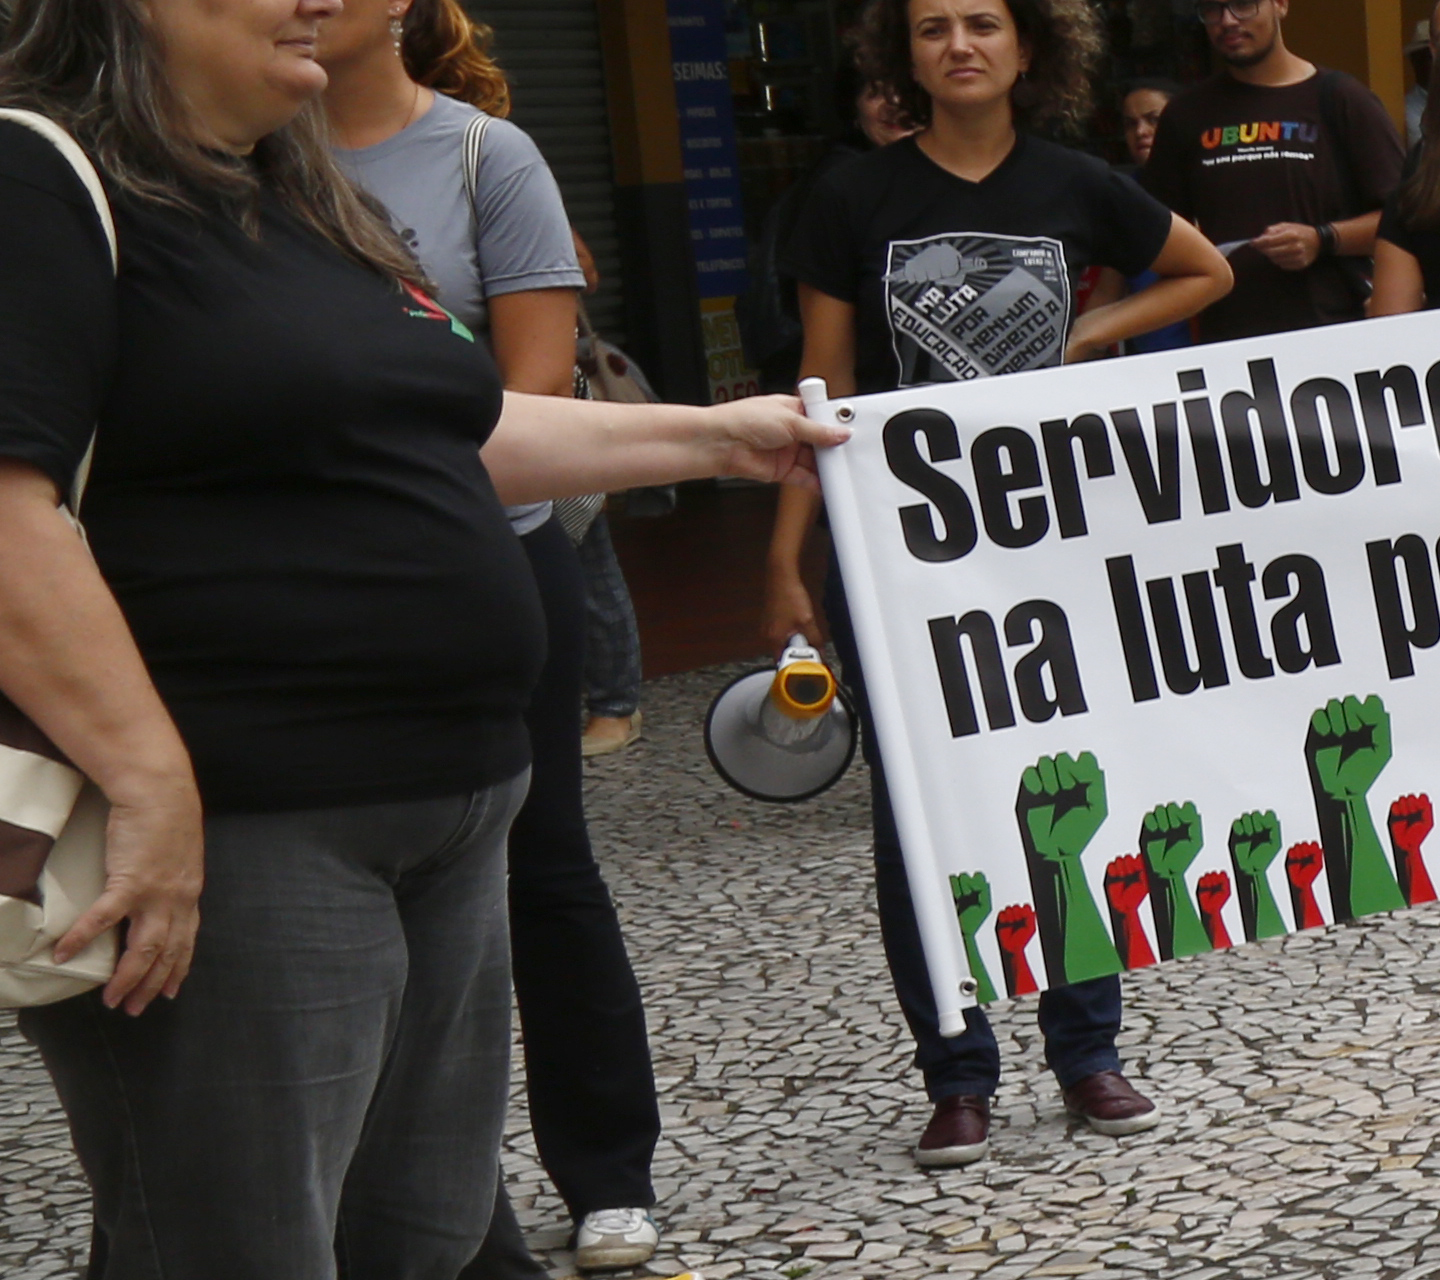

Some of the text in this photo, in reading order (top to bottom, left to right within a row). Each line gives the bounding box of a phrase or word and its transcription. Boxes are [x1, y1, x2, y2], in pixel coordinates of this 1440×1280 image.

[1201, 120, 1319, 150] UBUNTU
[914, 286, 945, 315] NA
[930, 284, 979, 326] LUTA
[951, 306, 989, 341] POR
[926, 599, 1085, 739] na
[1107, 548, 1341, 704] luta
